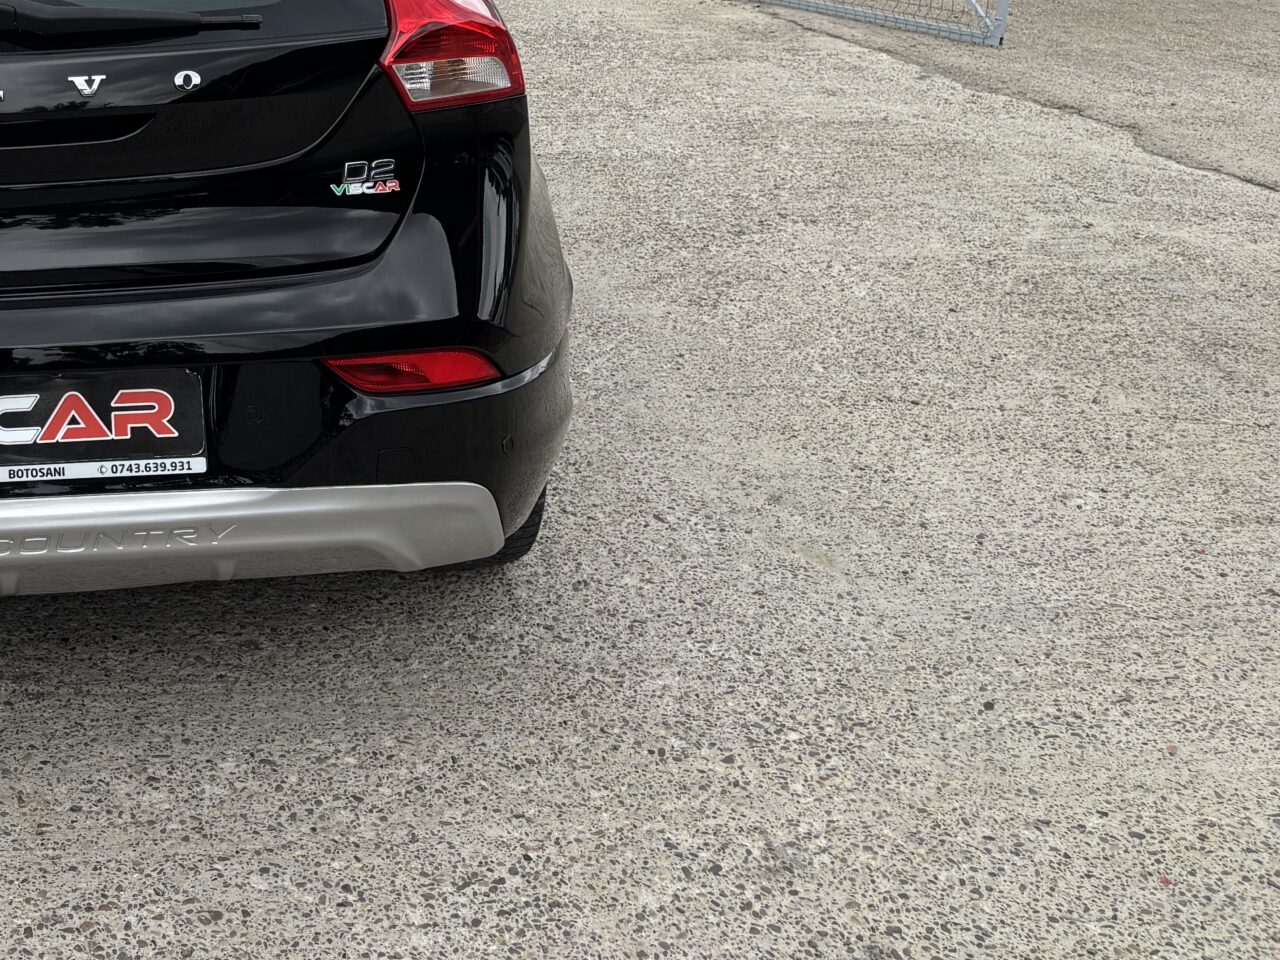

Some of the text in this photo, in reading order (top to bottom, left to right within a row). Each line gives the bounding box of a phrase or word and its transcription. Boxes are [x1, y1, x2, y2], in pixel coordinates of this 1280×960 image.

[343, 159, 396, 184] D2
[330, 179, 401, 196] VISCAR
[8, 466, 66, 480] BOTOSANI
[110, 460, 193, 475] 0743.639.931
